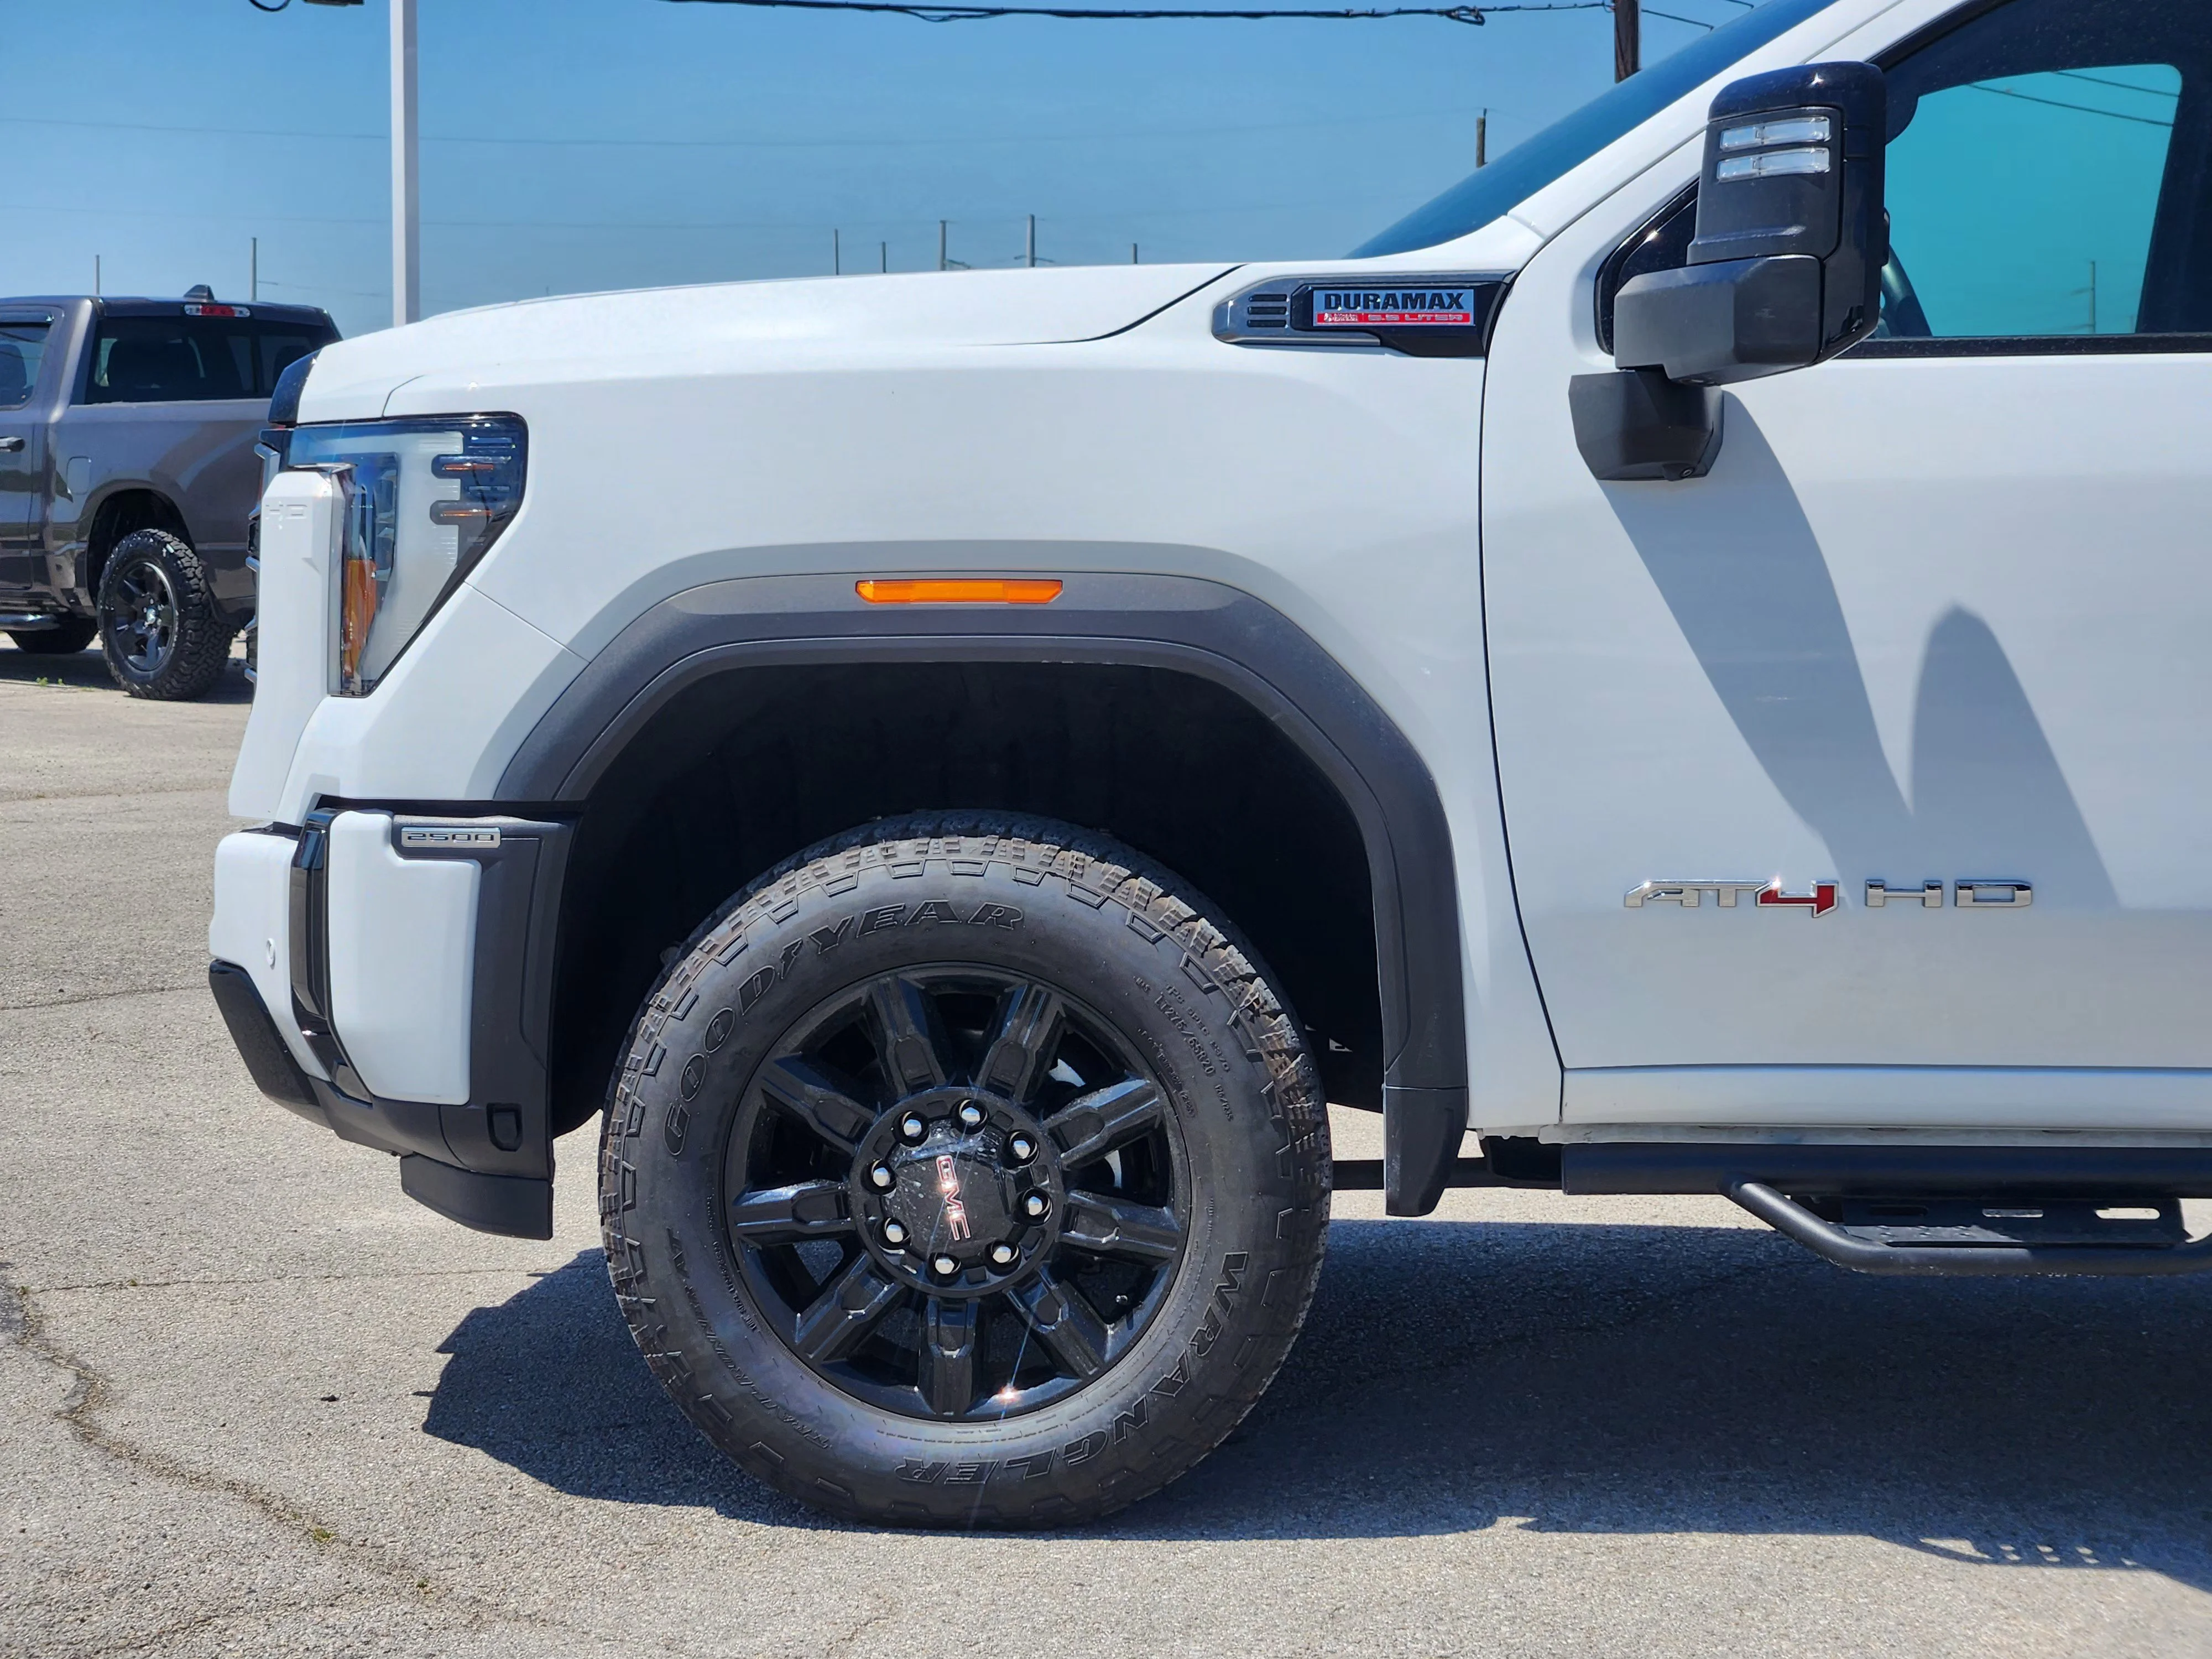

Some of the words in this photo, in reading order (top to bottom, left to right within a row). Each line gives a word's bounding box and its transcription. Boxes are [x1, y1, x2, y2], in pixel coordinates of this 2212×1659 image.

[1324, 293, 1464, 310] DURAMAX
[407, 833, 494, 842] 2500
[1624, 879, 1839, 917] AT4
[1865, 879, 2033, 907] HD
[664, 899, 1024, 1156] GOODYEAR
[1155, 995, 1215, 1076] LT275/65R20
[936, 1155, 971, 1241] GMC
[894, 1251, 1248, 1485] WRANGLER
